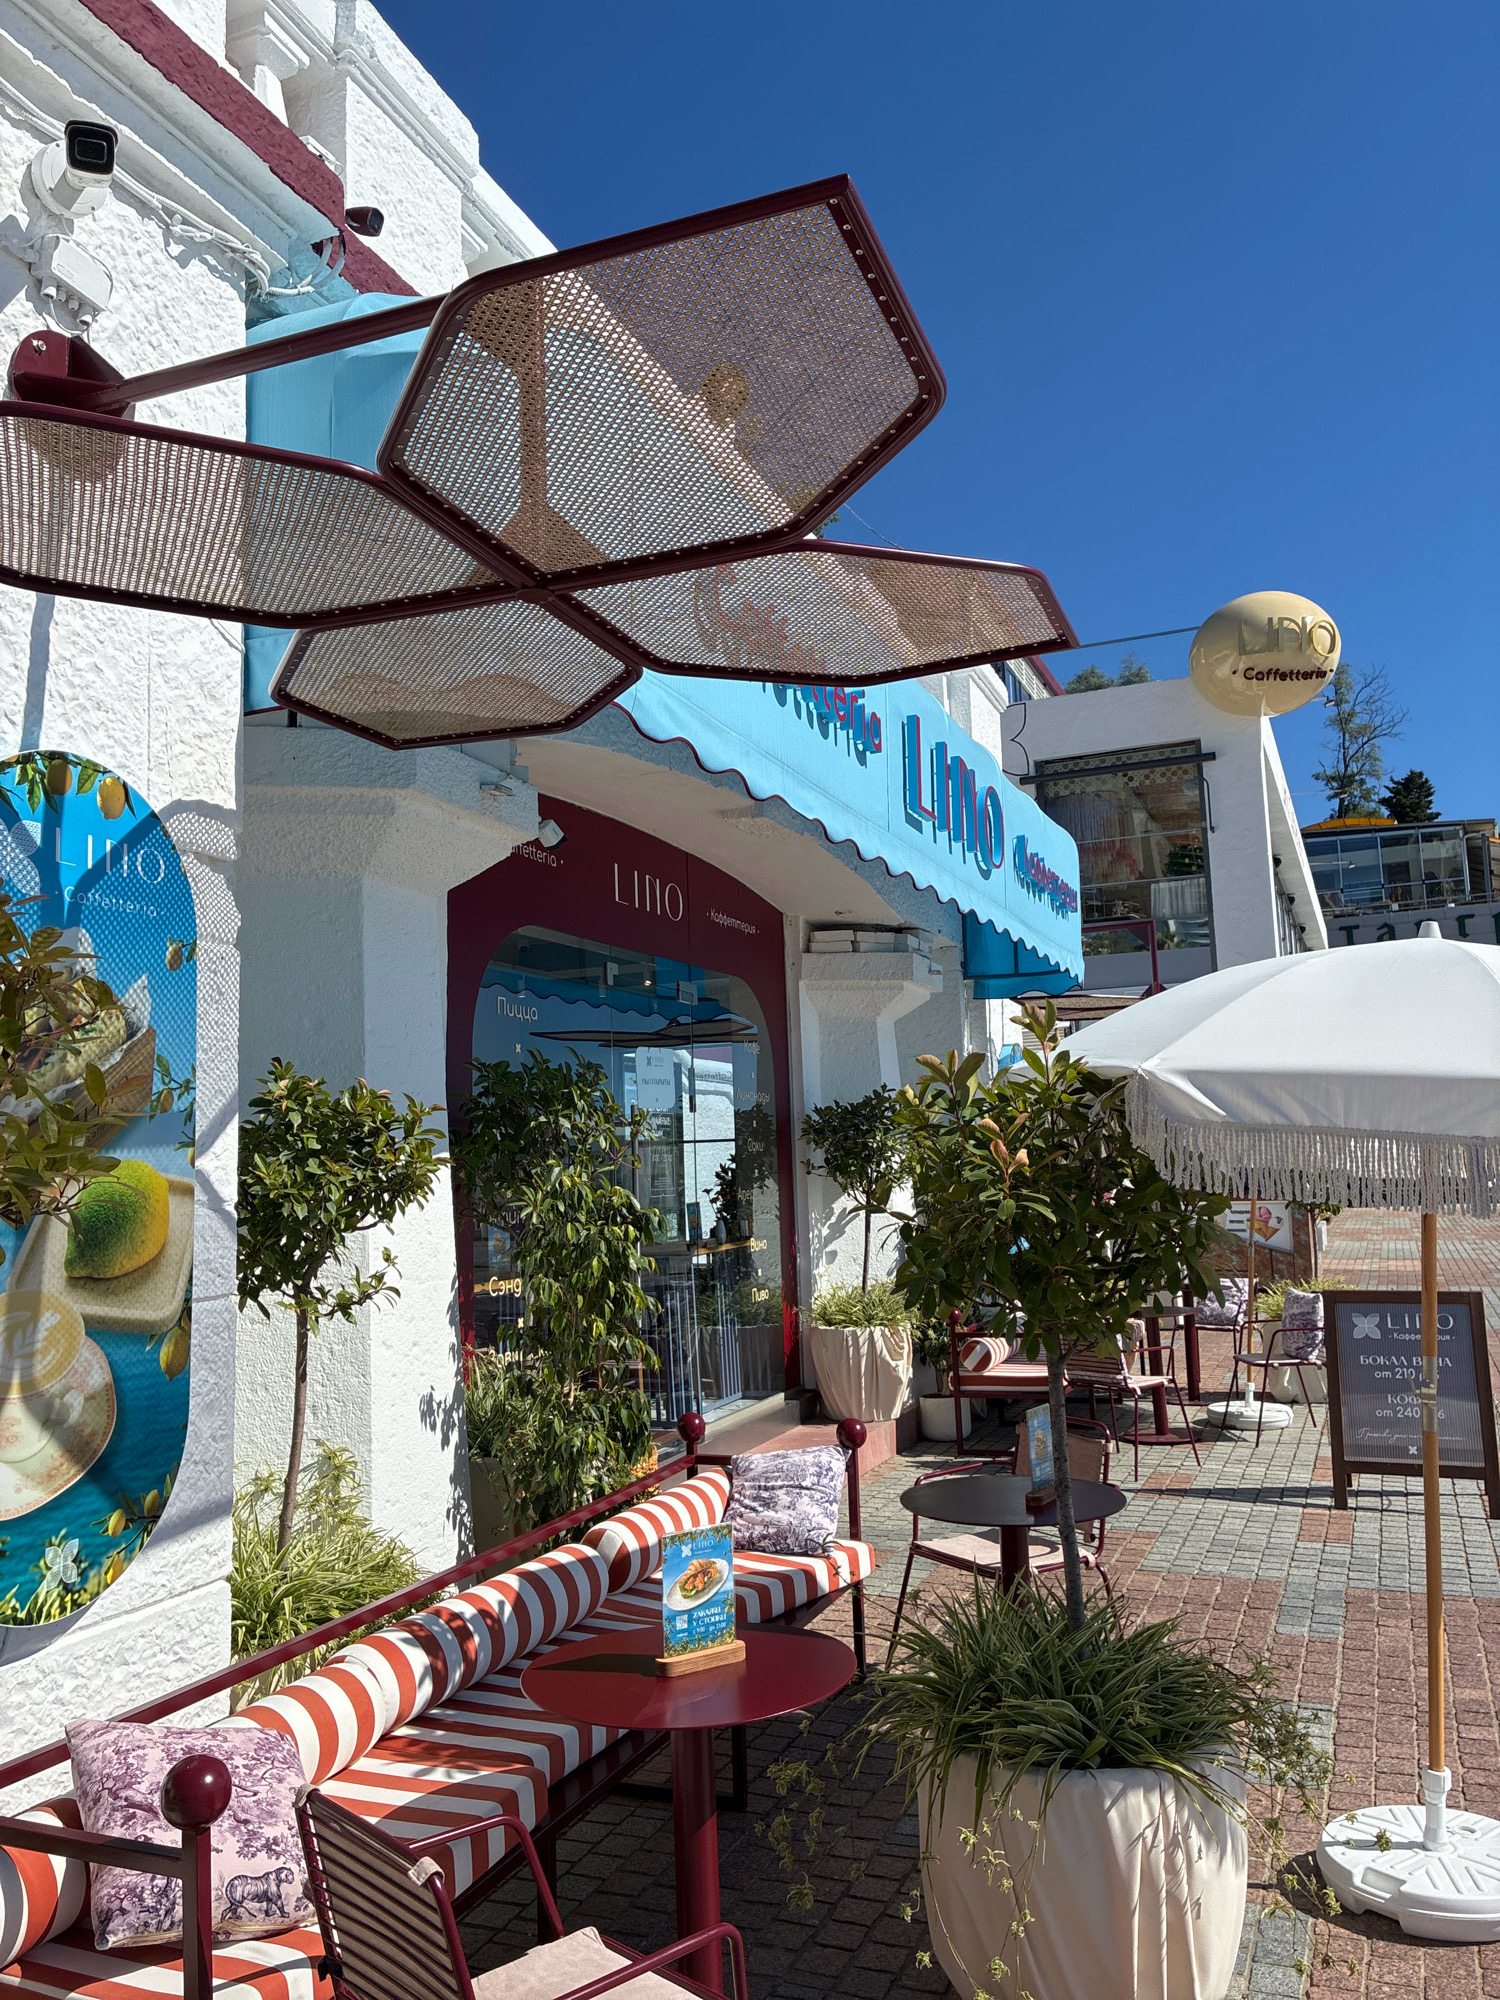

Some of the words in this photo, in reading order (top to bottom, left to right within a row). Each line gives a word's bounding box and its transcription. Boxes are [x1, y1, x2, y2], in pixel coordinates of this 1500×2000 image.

[1238, 616, 1337, 657] LINO
[1243, 666, 1328, 682] Caffetteria
[906, 714, 1005, 870] LINO
[55, 827, 165, 884] LINO
[511, 843, 558, 868] ffetteria
[614, 862, 684, 922] LINO
[64, 886, 157, 918] Caffetteria
[710, 907, 756, 936] Каффеттерия
[497, 996, 539, 1023] Пицца
[743, 1039, 761, 1055] Кофе
[736, 1087, 771, 1106] Лимонады
[747, 1138, 765, 1153] Соки
[750, 1237, 768, 1252] Вино
[489, 1276, 522, 1298] Сэнд
[752, 1287, 770, 1303] Пиво
[1360, 1355, 1408, 1367] БОКАЛ
[1412, 1356, 1453, 1368] ВНА
[1374, 1371, 1392, 1379] от
[1395, 1368, 1416, 1379] 210
[1387, 1394, 1422, 1405] КОФ
[1375, 1409, 1393, 1417] от
[1396, 1407, 1421, 1418] 240
